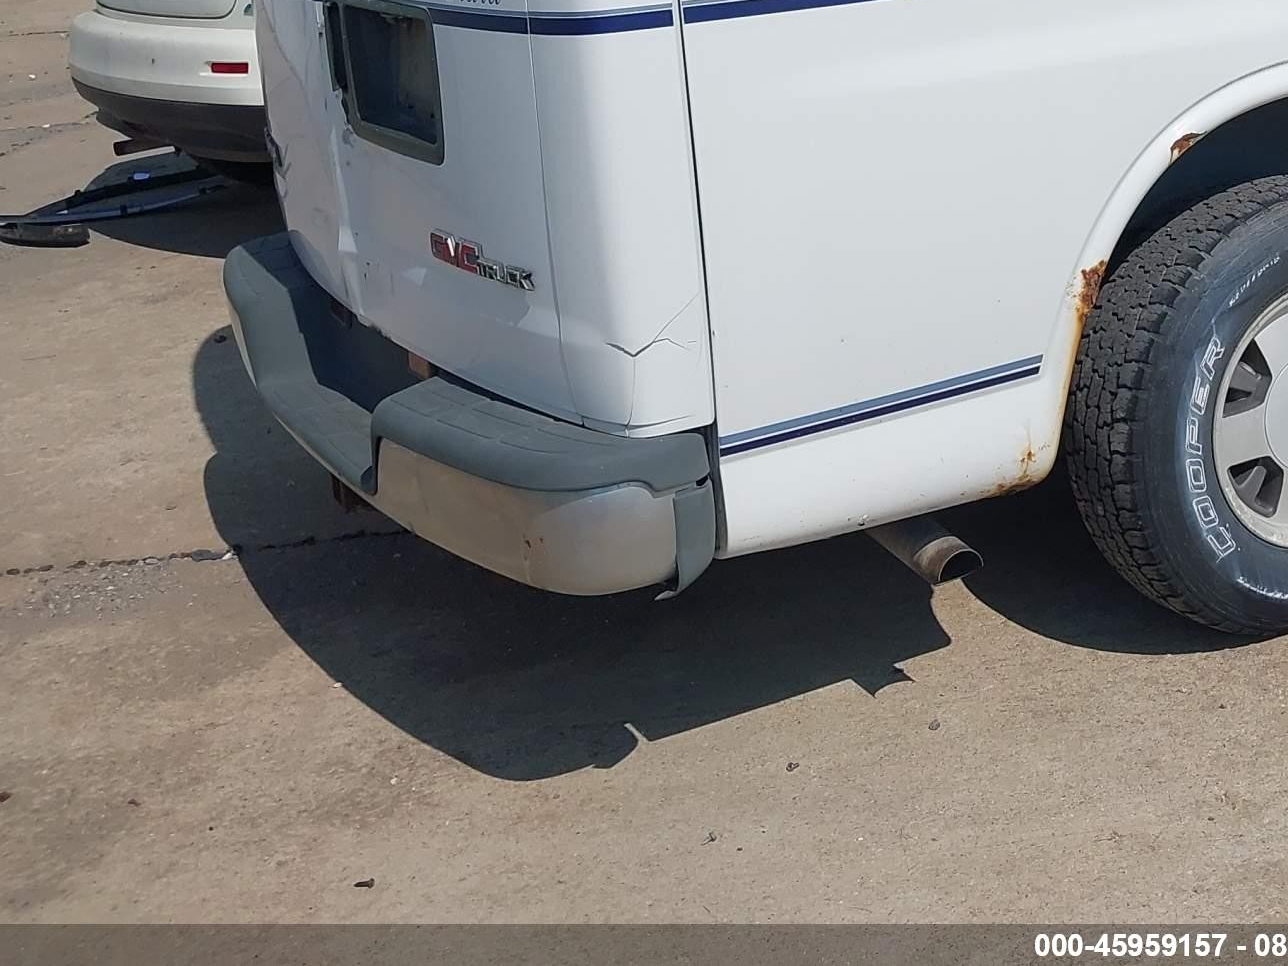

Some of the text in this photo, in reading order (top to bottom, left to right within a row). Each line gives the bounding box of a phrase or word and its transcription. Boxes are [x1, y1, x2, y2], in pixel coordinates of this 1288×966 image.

[430, 228, 536, 291] GMC TRUCK
[1184, 336, 1237, 564] COOPER
